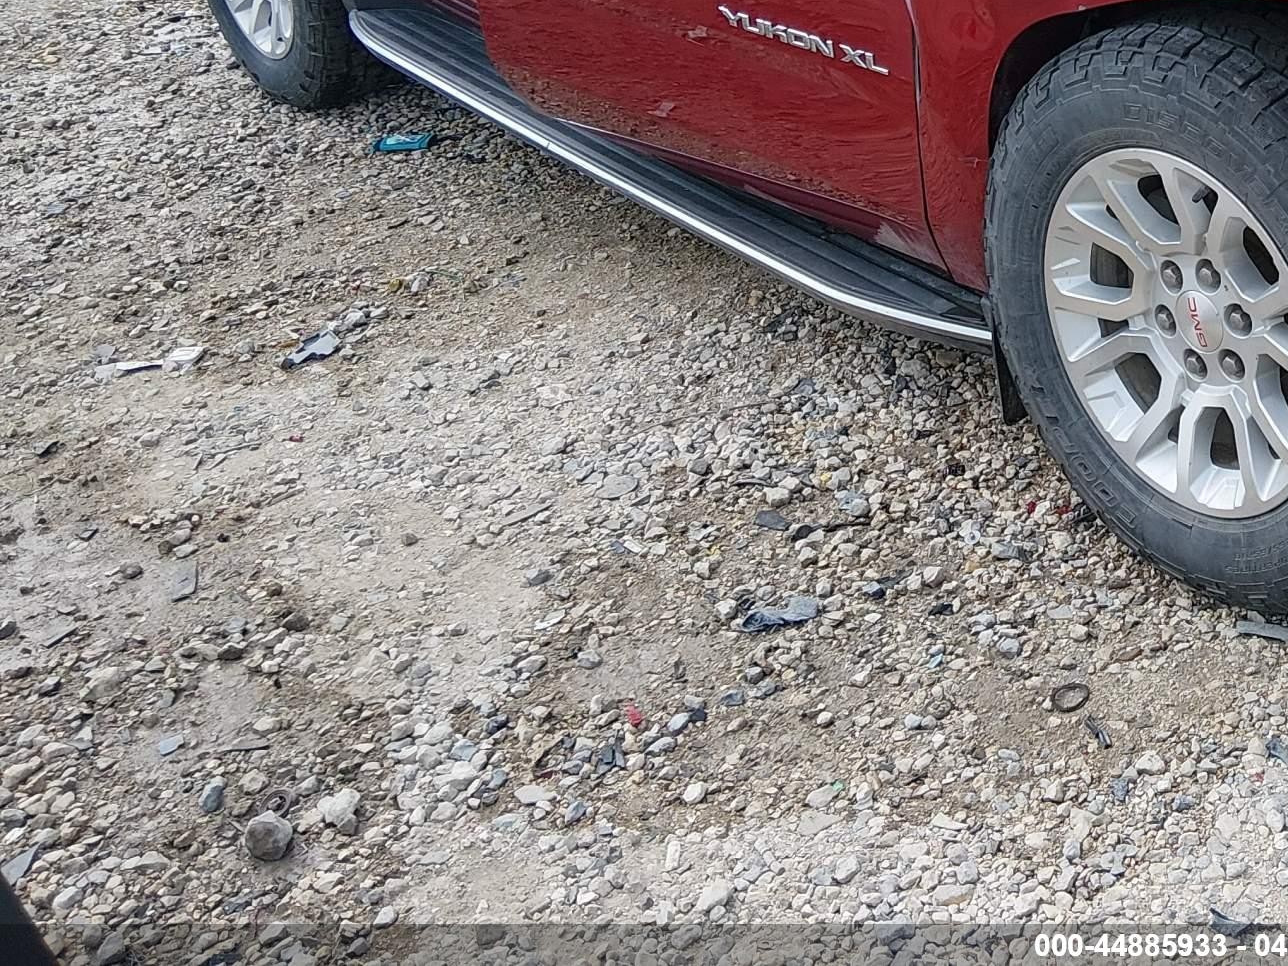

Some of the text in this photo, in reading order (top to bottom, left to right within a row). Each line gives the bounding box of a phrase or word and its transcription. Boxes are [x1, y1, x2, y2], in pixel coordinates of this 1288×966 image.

[718, 5, 889, 76] YUKON XL
[1186, 296, 1209, 348] GMC
